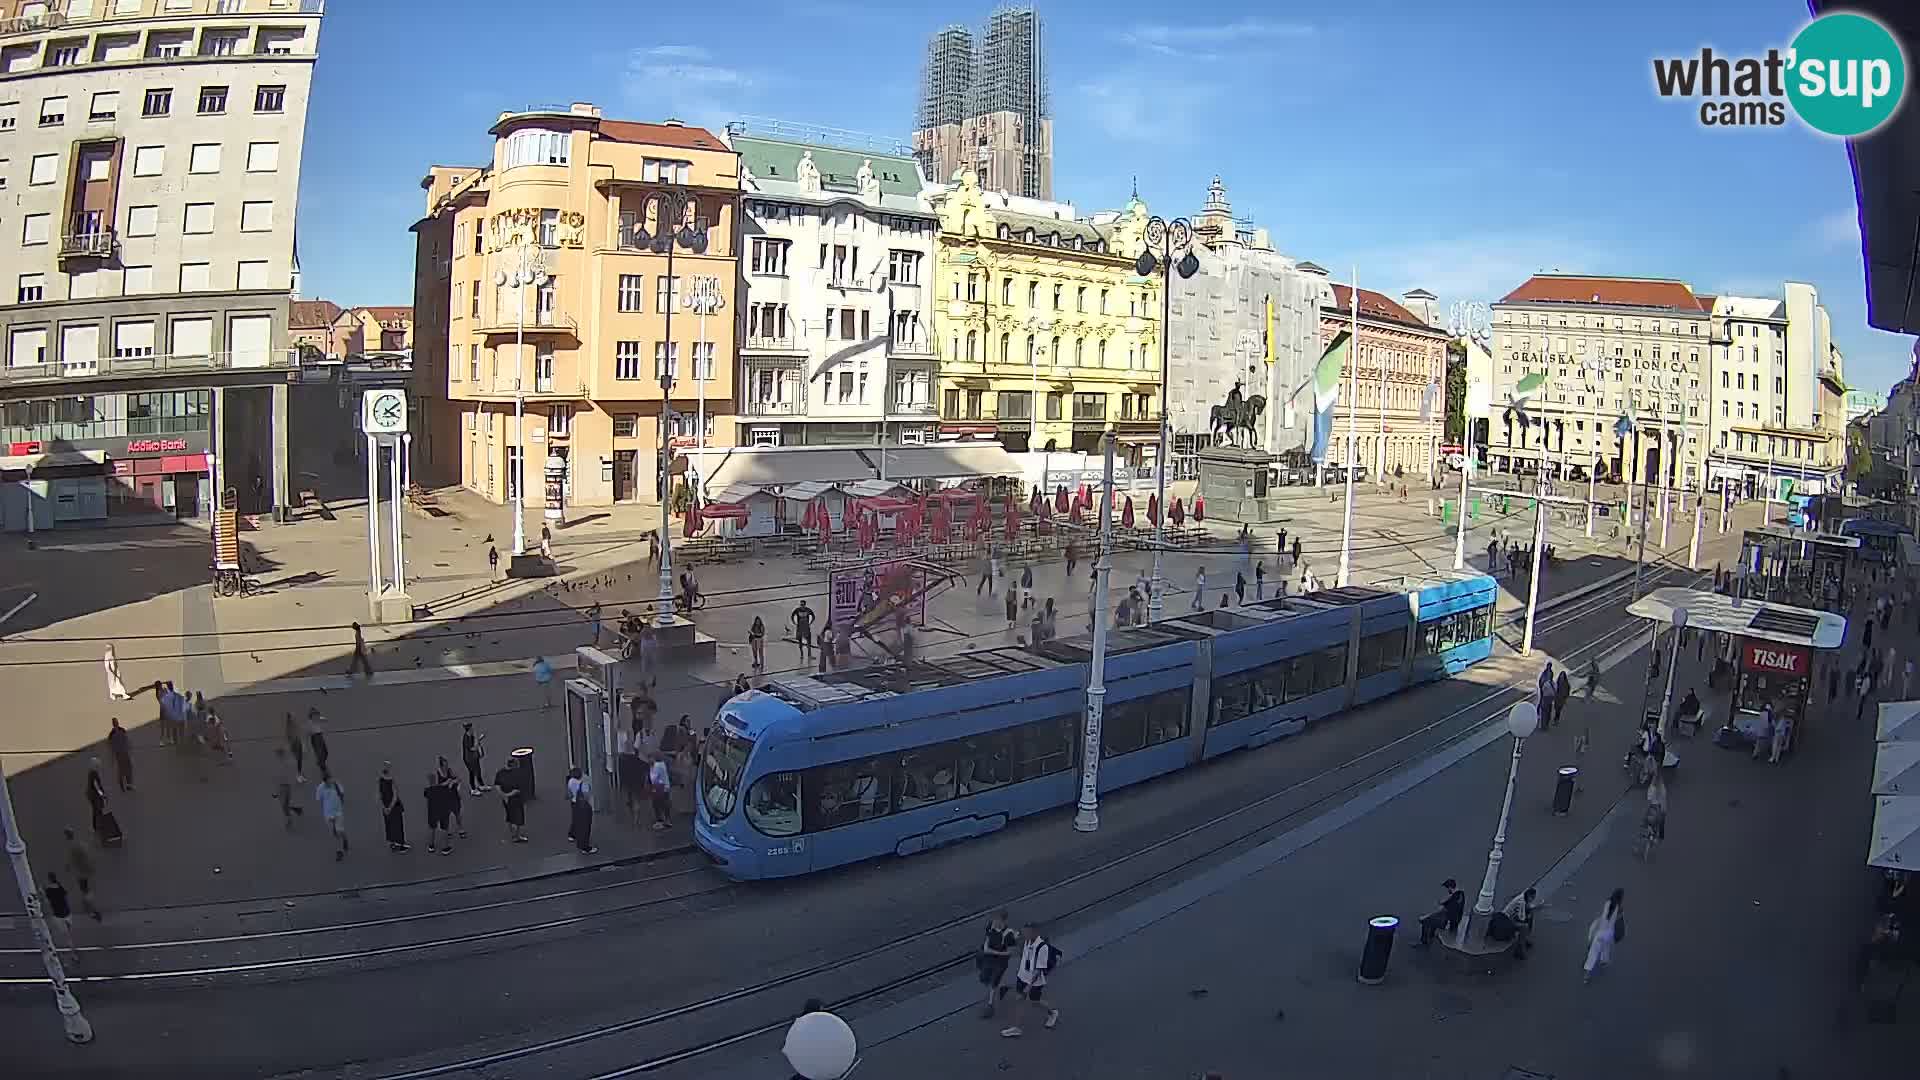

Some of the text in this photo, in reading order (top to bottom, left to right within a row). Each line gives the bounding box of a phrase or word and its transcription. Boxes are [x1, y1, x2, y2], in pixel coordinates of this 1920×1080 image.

[1593, 356, 1688, 374] EDIONICA
[160, 439, 186, 450] Bank
[1753, 648, 1798, 670] TISAK
